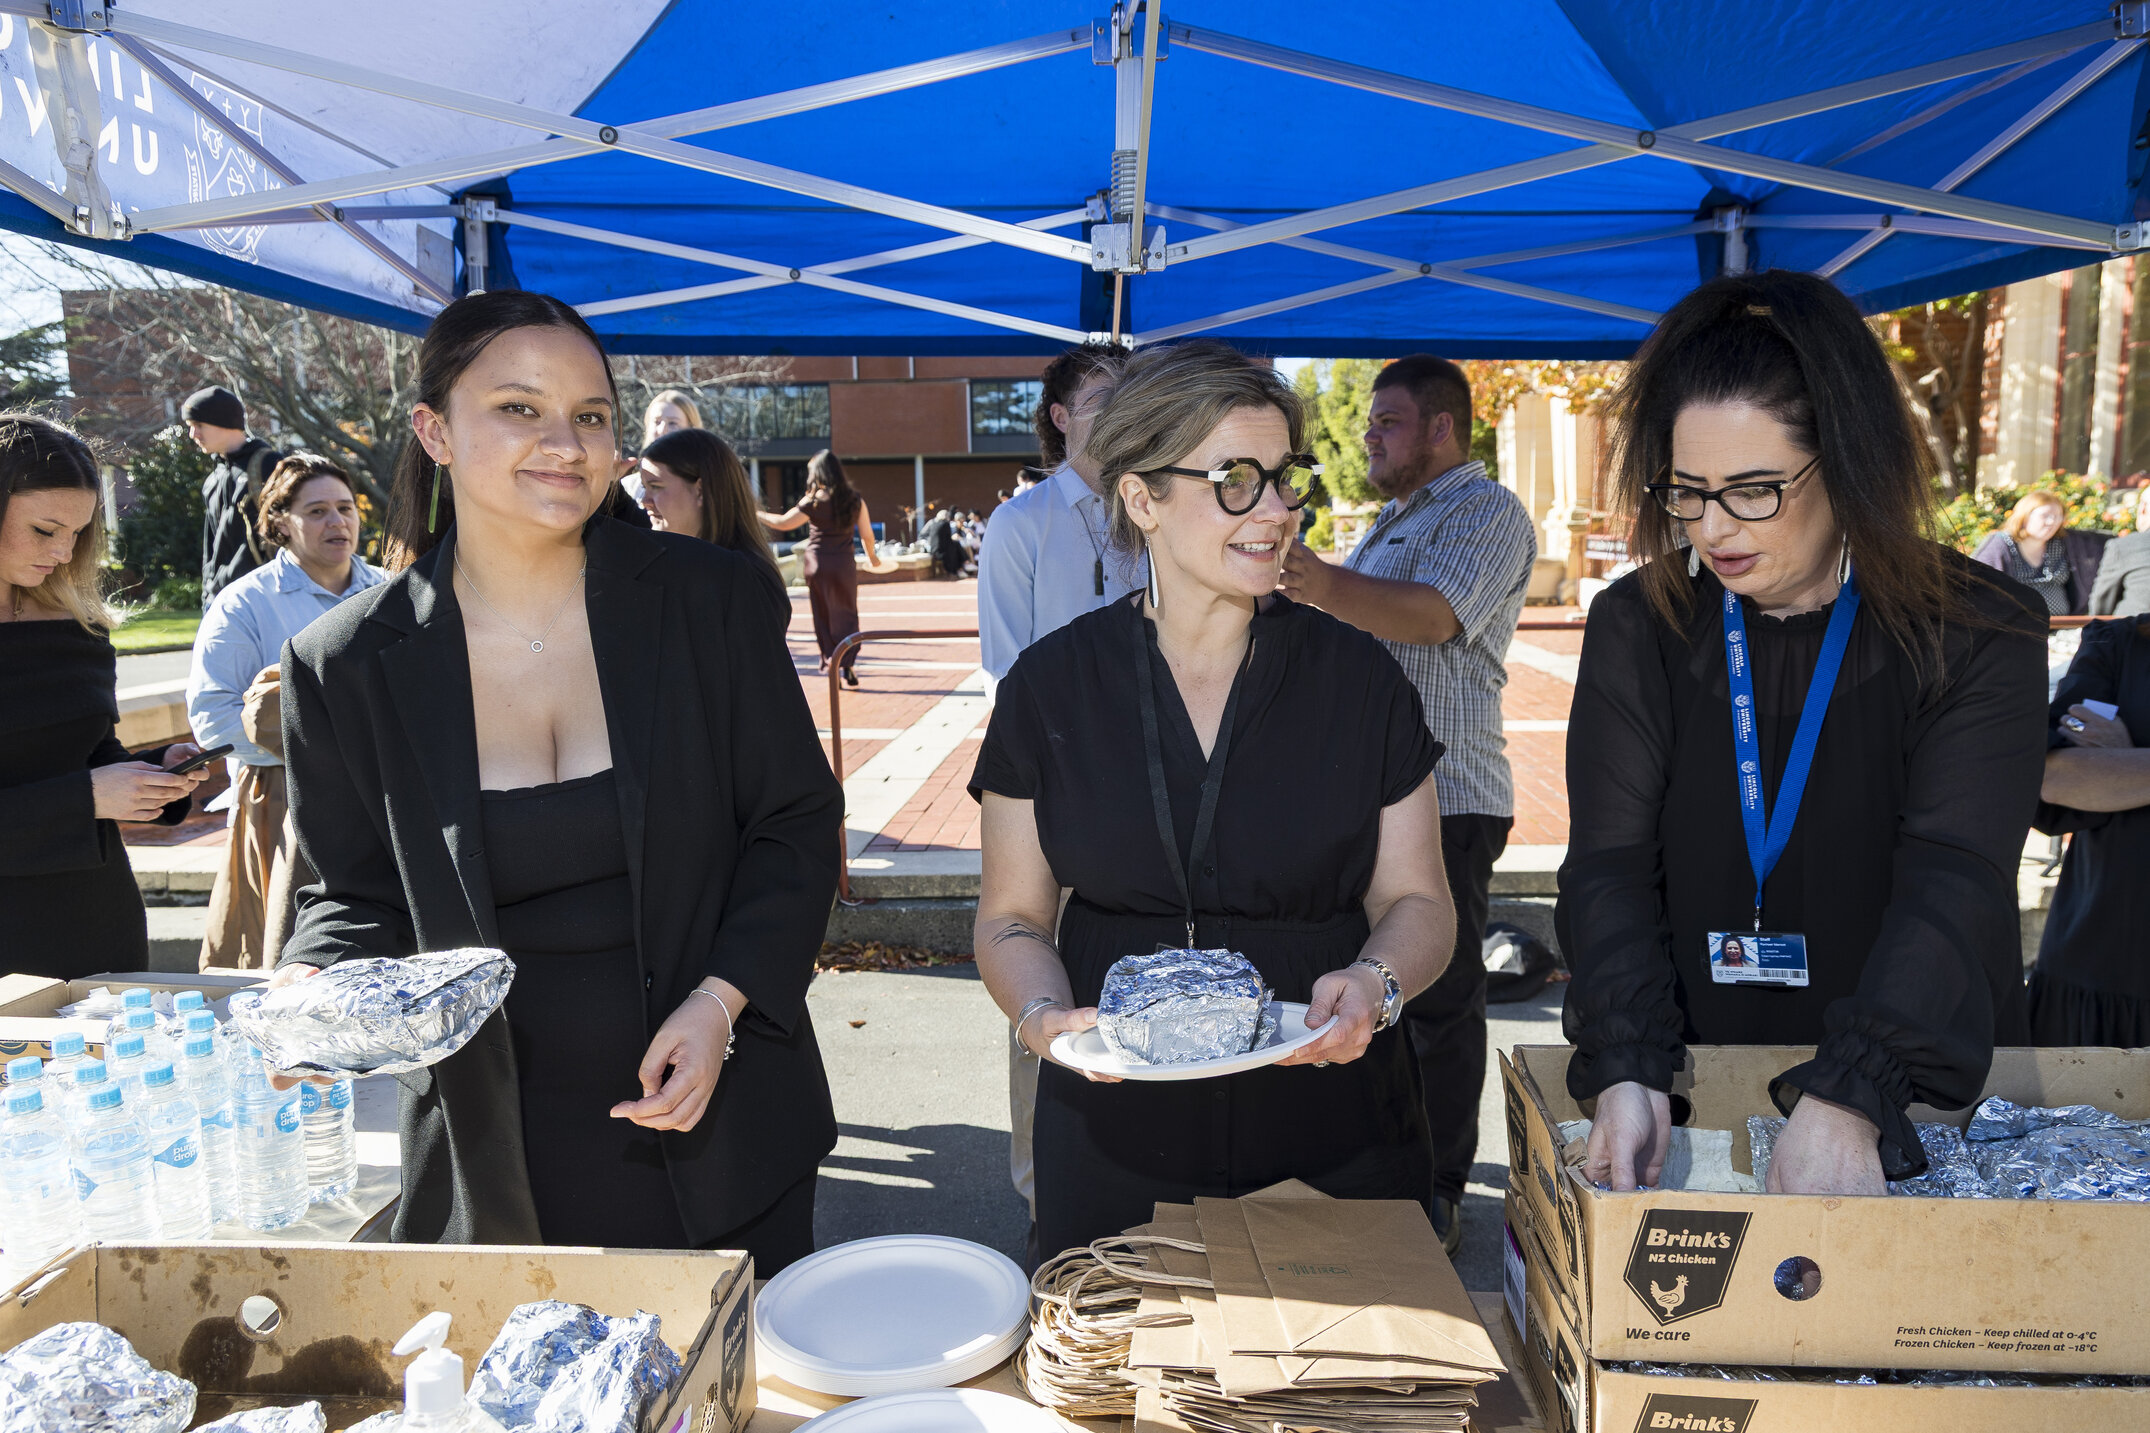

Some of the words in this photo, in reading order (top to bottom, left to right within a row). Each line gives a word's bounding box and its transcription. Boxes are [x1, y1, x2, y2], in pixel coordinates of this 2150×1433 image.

[1646, 1227, 1732, 1249] Brink's
[1648, 1253, 1667, 1263] NZ
[1667, 1253, 1717, 1265] Chicken
[1626, 1327, 1651, 1340] We
[1654, 1330, 1691, 1341] care
[1896, 1326, 1926, 1335] Fresh
[1929, 1326, 1972, 1337] Chicken
[1984, 1328, 2010, 1339] Keep
[2012, 1329, 2051, 1339] chilled
[2052, 1330, 2064, 1339] at
[1894, 1339, 1930, 1348] Frozen
[1933, 1339, 1976, 1349] Chicken
[1987, 1341, 2014, 1351] Keep
[2014, 1341, 2051, 1352] frozen
[2053, 1343, 2066, 1351] at
[1649, 1411, 1737, 1433] Brink's
